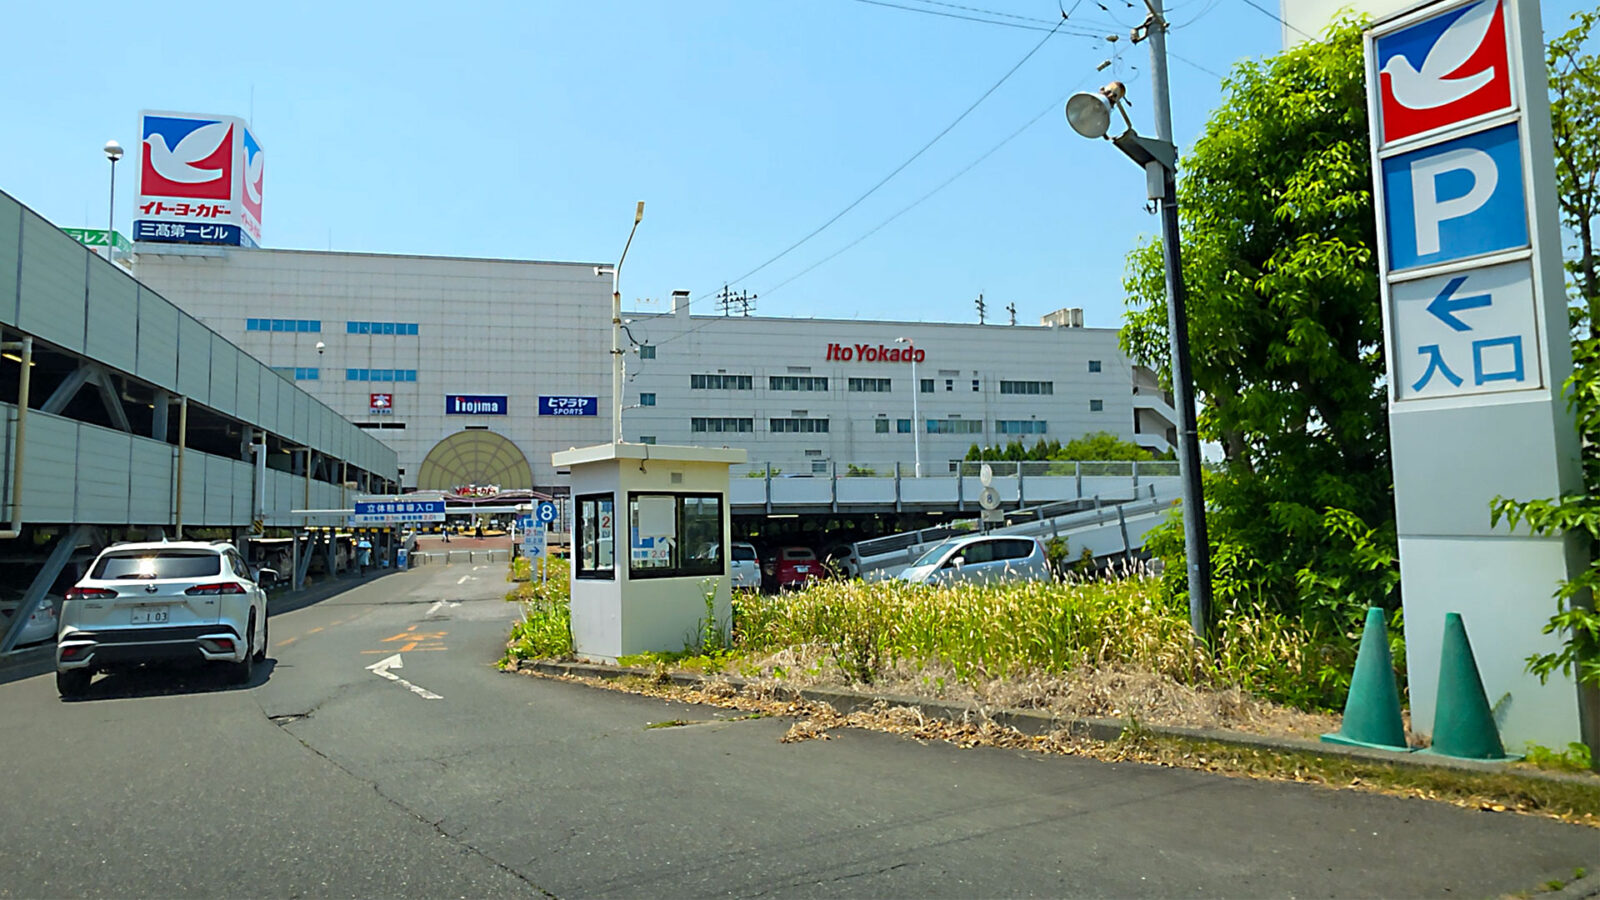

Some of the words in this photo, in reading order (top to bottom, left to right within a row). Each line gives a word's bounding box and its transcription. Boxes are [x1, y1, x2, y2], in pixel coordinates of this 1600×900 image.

[139, 201, 231, 218] イトーヨーカドー
[1410, 147, 1499, 257] P
[1411, 335, 1525, 393] 入口
[548, 398, 588, 408] ヒマラヤ
[541, 505, 553, 521] 8
